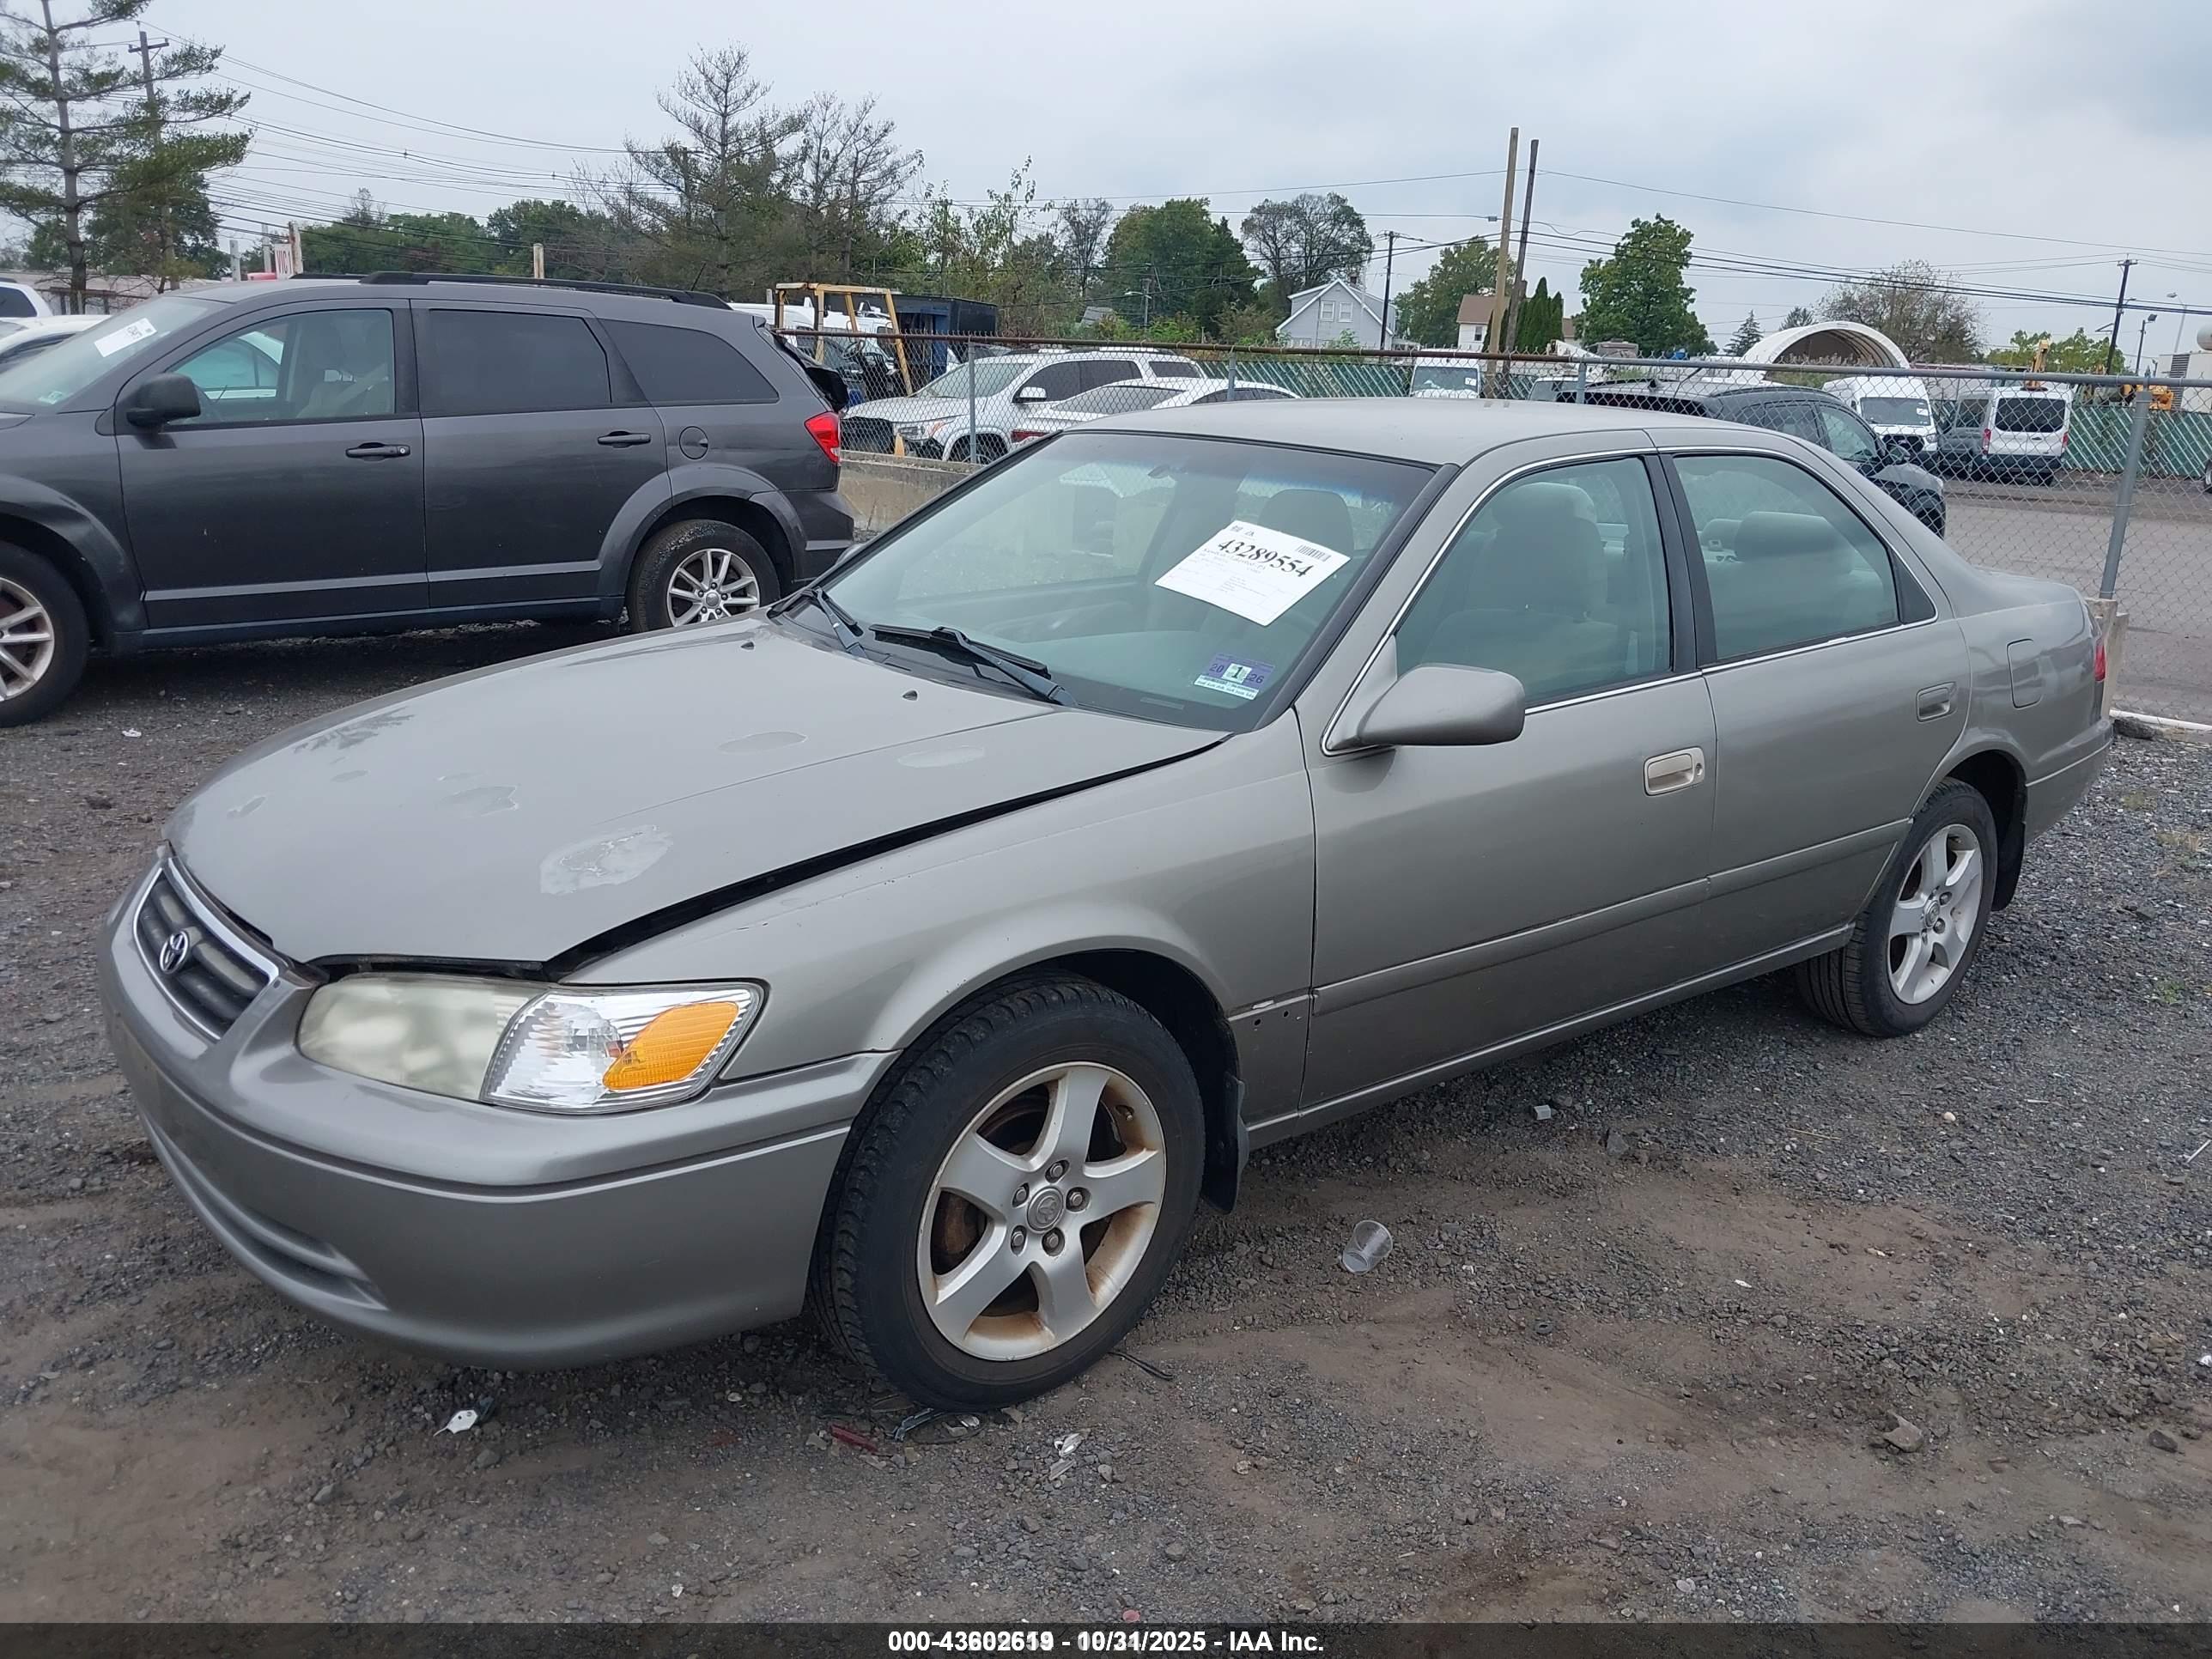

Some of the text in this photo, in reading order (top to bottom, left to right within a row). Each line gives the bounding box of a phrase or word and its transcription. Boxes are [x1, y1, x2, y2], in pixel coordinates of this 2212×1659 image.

[1218, 538, 1315, 578] 43289554
[1209, 663, 1265, 684] 20 1 26
